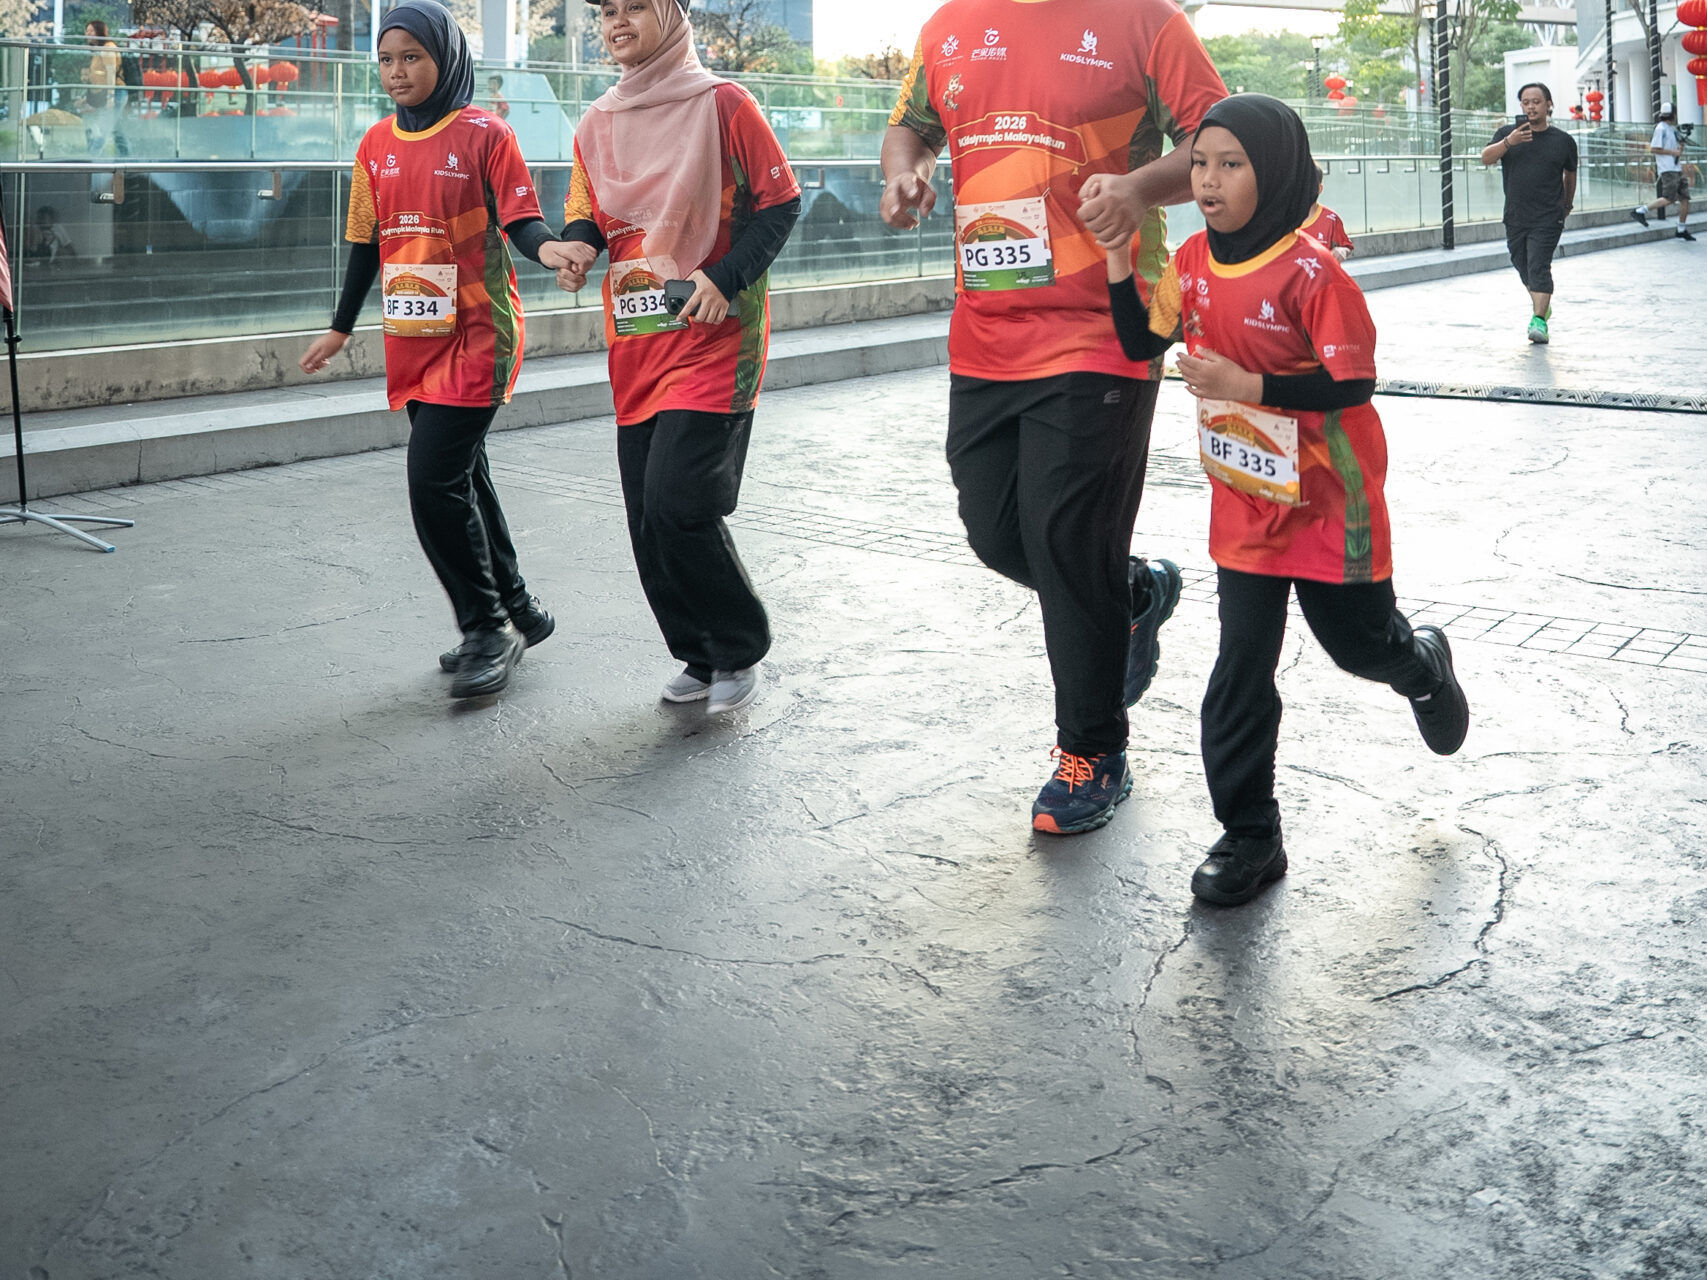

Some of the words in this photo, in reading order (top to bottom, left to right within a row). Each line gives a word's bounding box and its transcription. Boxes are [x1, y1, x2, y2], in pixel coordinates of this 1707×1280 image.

[1060, 53, 1114, 70] KIDSLYMPIC
[994, 116, 1027, 130] 2026
[434, 169, 471, 180] KIDSLYMPIC
[399, 214, 420, 225] 2026
[965, 248, 988, 267] PG
[993, 245, 1031, 265] 335
[387, 299, 399, 315] BF
[404, 300, 438, 316] 334
[620, 297, 636, 315] PG
[1244, 317, 1290, 334] KIDSLYMPIC
[1211, 436, 1232, 460] BF
[1239, 448, 1276, 477] 335
